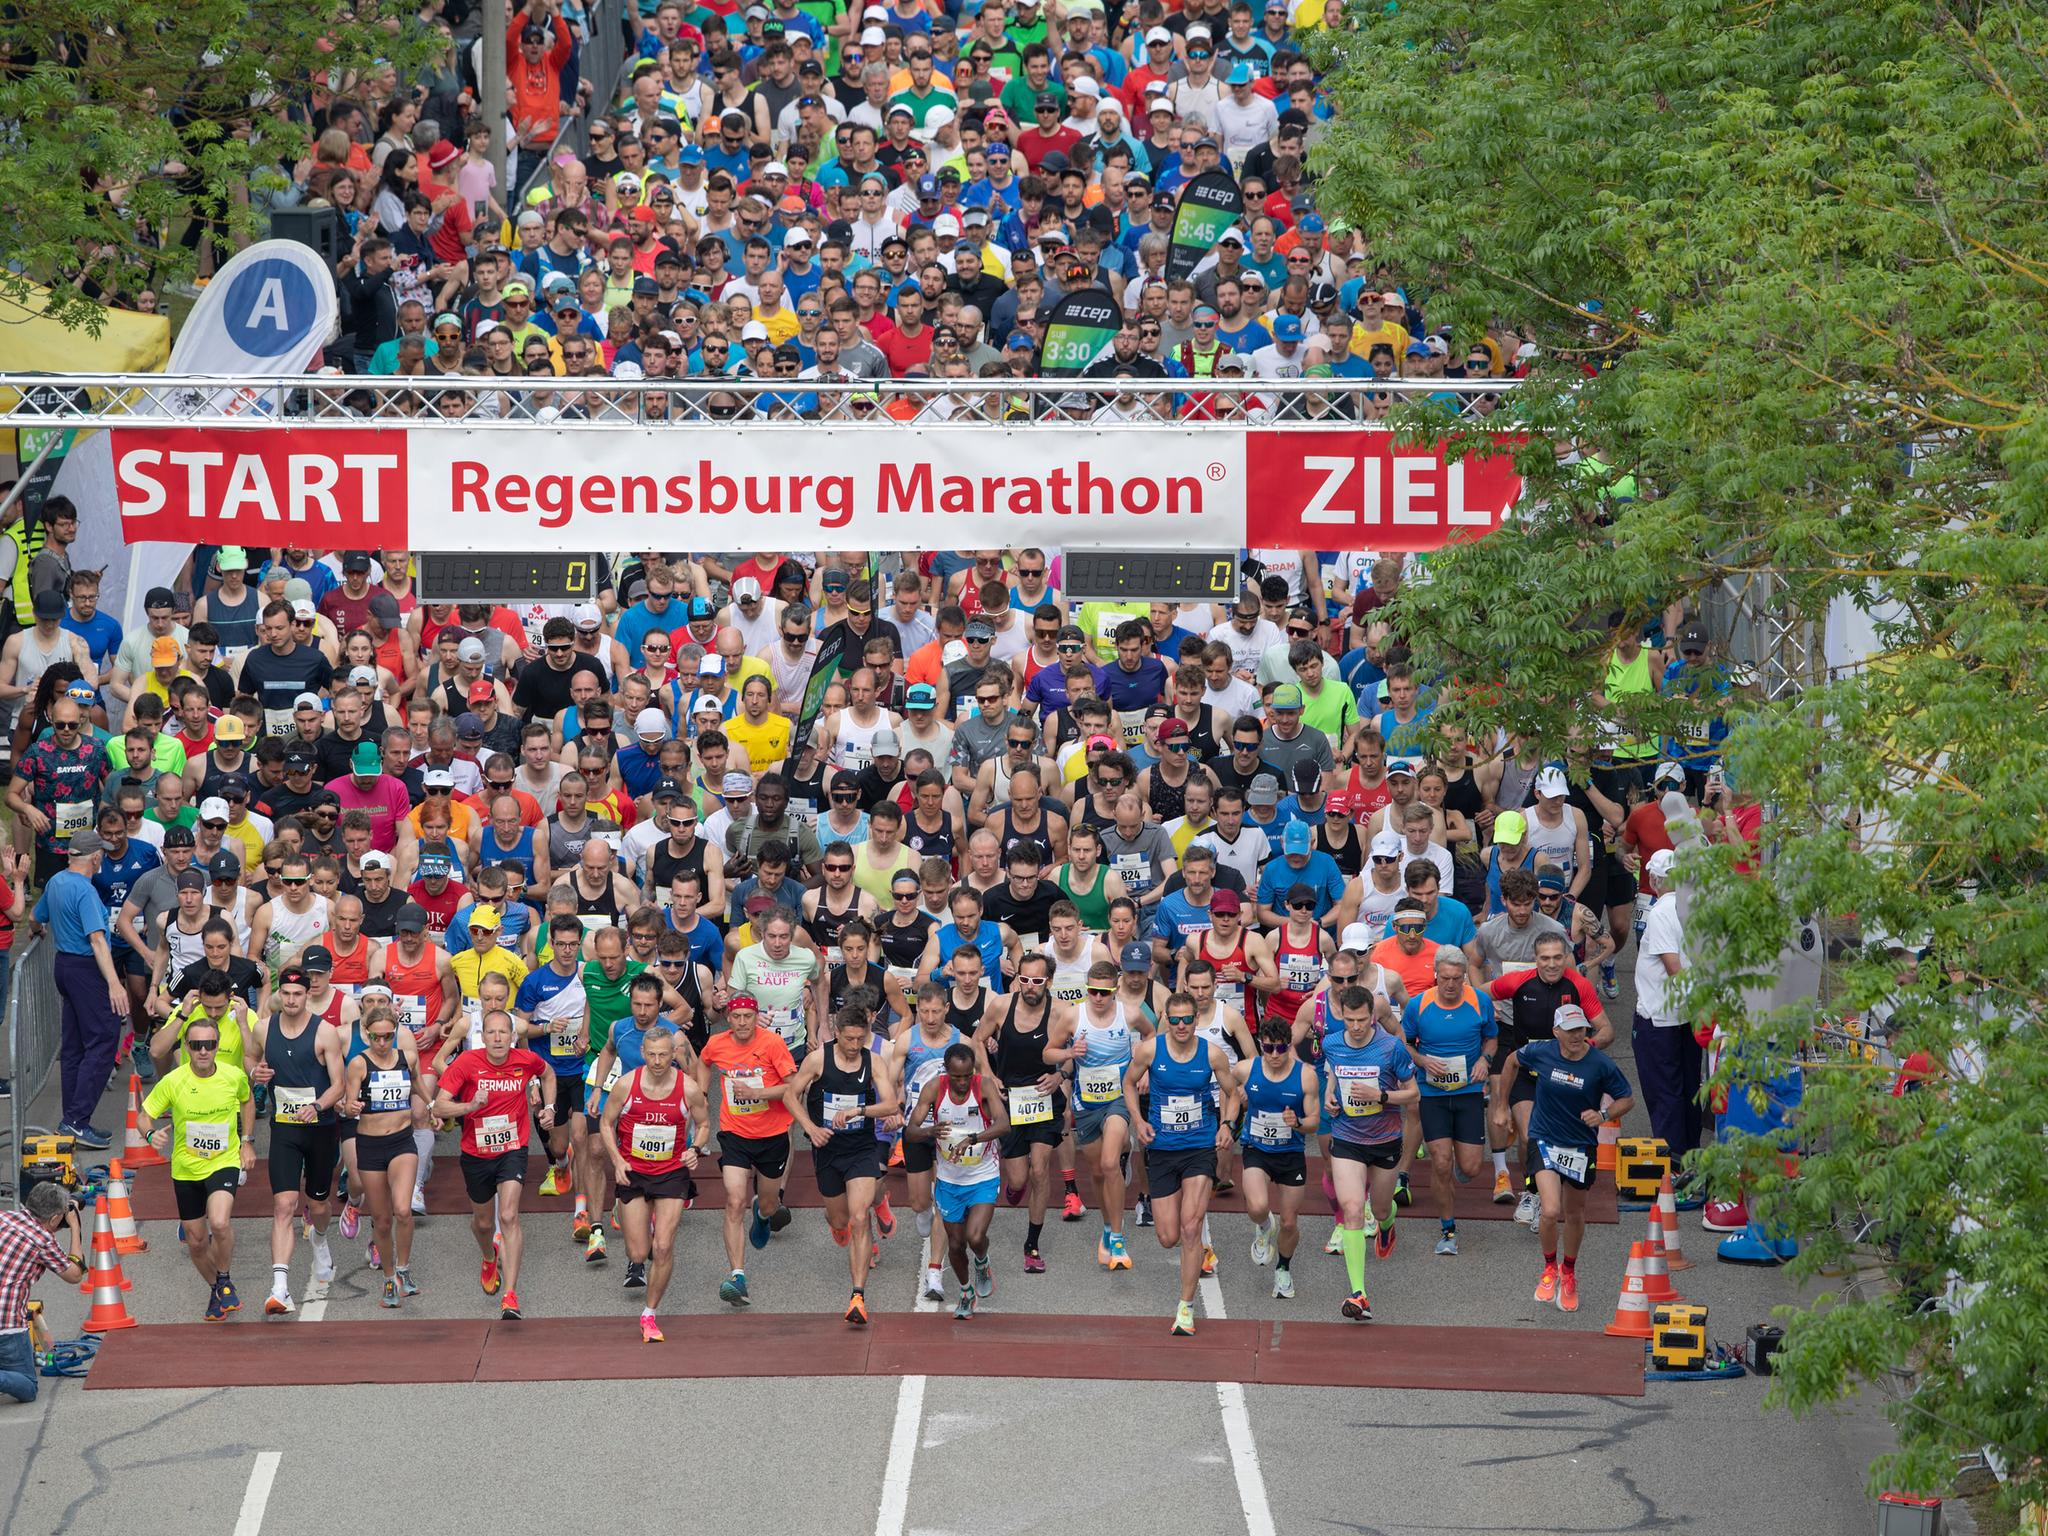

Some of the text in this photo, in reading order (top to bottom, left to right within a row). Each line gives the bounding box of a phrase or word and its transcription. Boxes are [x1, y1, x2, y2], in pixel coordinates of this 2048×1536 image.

[1208, 187, 1235, 206] cep
[1179, 219, 1216, 243] 3:45
[245, 277, 289, 331] A
[1080, 306, 1112, 323] cep
[1051, 331, 1067, 339] SUB
[1047, 342, 1091, 361] 3:30
[118, 449, 398, 523] START
[1300, 455, 1492, 525] ZIEL
[451, 460, 854, 528] Regensburg
[1265, 562, 1296, 573] SRAM
[1356, 556, 1376, 567] am
[532, 634, 542, 645] 29
[56, 765, 89, 774] SAYSKY
[64, 817, 88, 830] 2998
[1121, 870, 1141, 881] 824
[757, 976, 789, 986] LAUF
[1290, 971, 1310, 982] 213
[1057, 988, 1083, 1001] 4328
[477, 1078, 523, 1091] GERMANY
[1086, 1081, 1114, 1093] 3282
[383, 1088, 402, 1101] 212
[1017, 1101, 1045, 1115] 4076
[645, 1111, 668, 1122] DJK
[1175, 1111, 1189, 1123] 20
[484, 1130, 511, 1145] 9139
[1264, 1127, 1278, 1138] 32
[193, 1138, 221, 1151] 2456
[639, 1140, 666, 1152] 4091
[1556, 1153, 1574, 1168] 831
